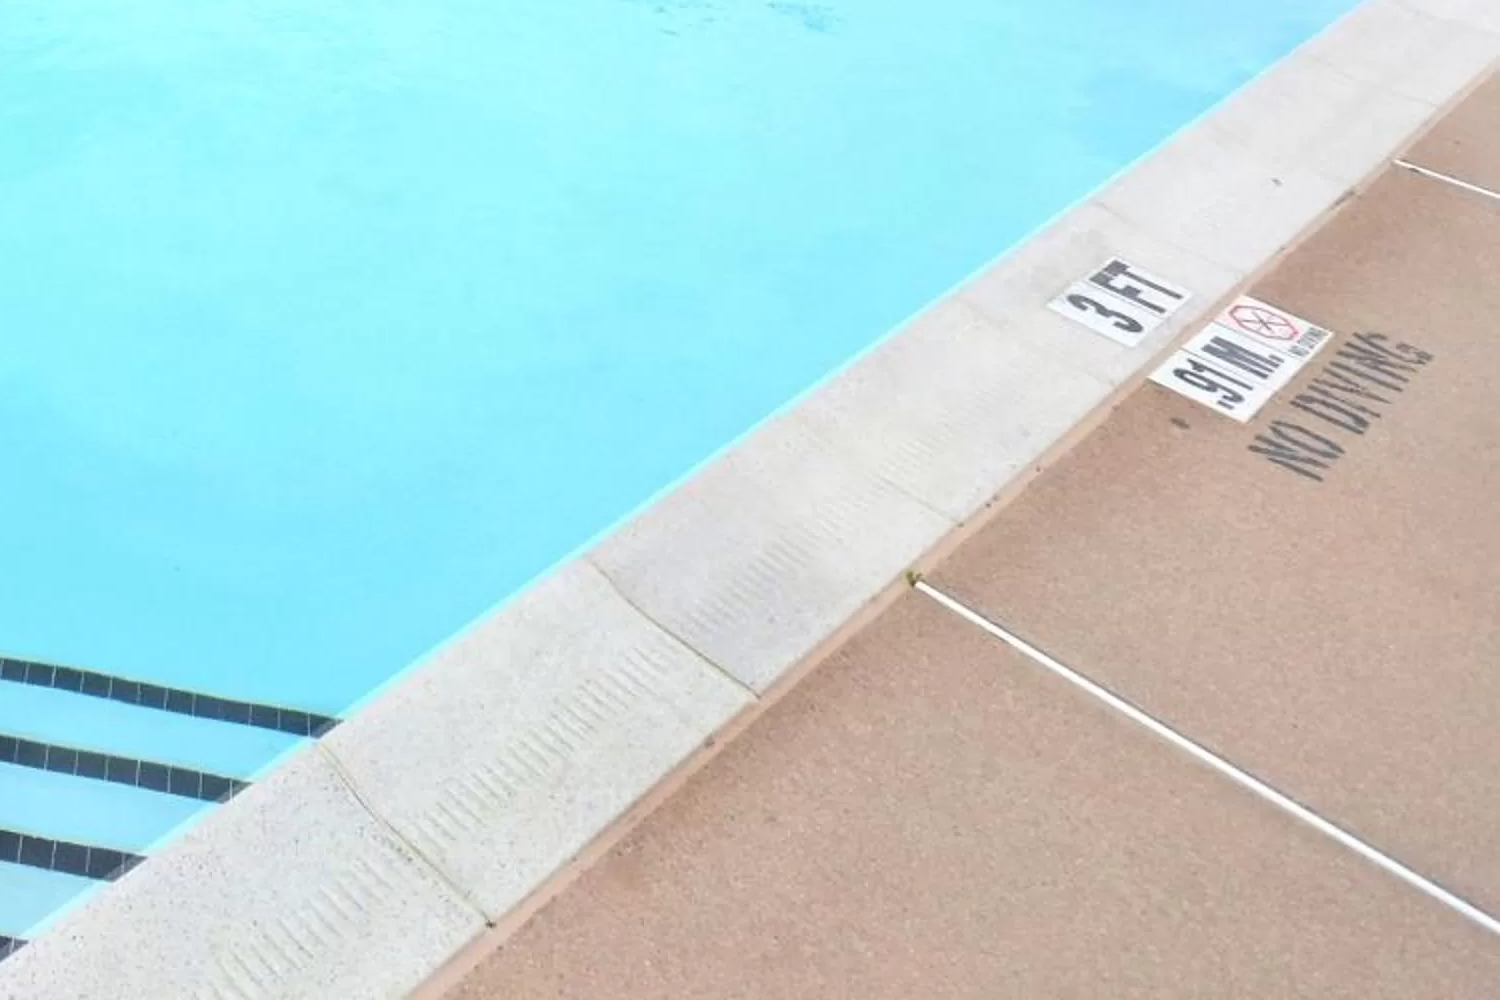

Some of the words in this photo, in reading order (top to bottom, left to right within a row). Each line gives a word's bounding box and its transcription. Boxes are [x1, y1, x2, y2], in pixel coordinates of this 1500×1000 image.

[1066, 293, 1144, 333] 3
[1088, 259, 1184, 314] FT
[1290, 331, 1434, 436] DIVING
[1247, 419, 1346, 482] NO
